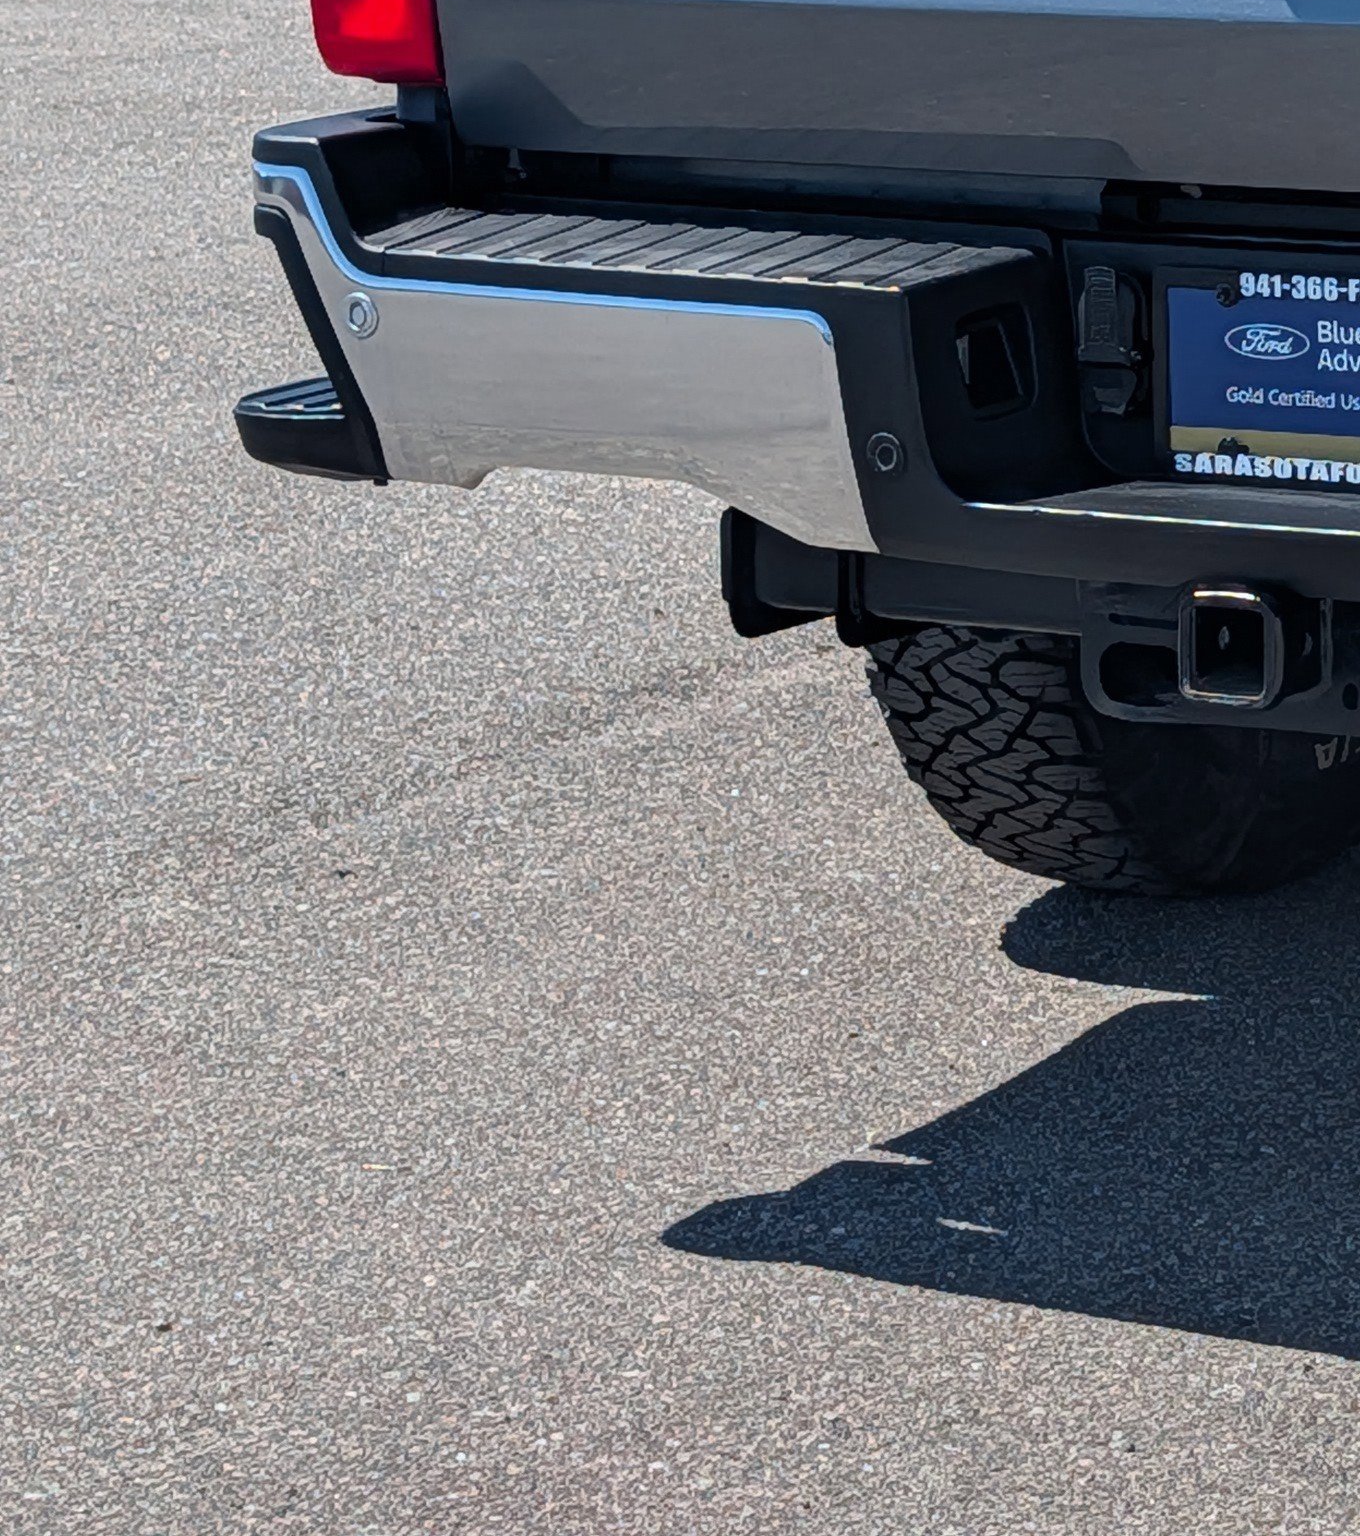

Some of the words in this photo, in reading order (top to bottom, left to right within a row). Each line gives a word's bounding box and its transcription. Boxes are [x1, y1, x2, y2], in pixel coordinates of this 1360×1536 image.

[1240, 327, 1294, 356] Ford
[1225, 385, 1264, 406] Gold
[1267, 387, 1336, 410] Certified
